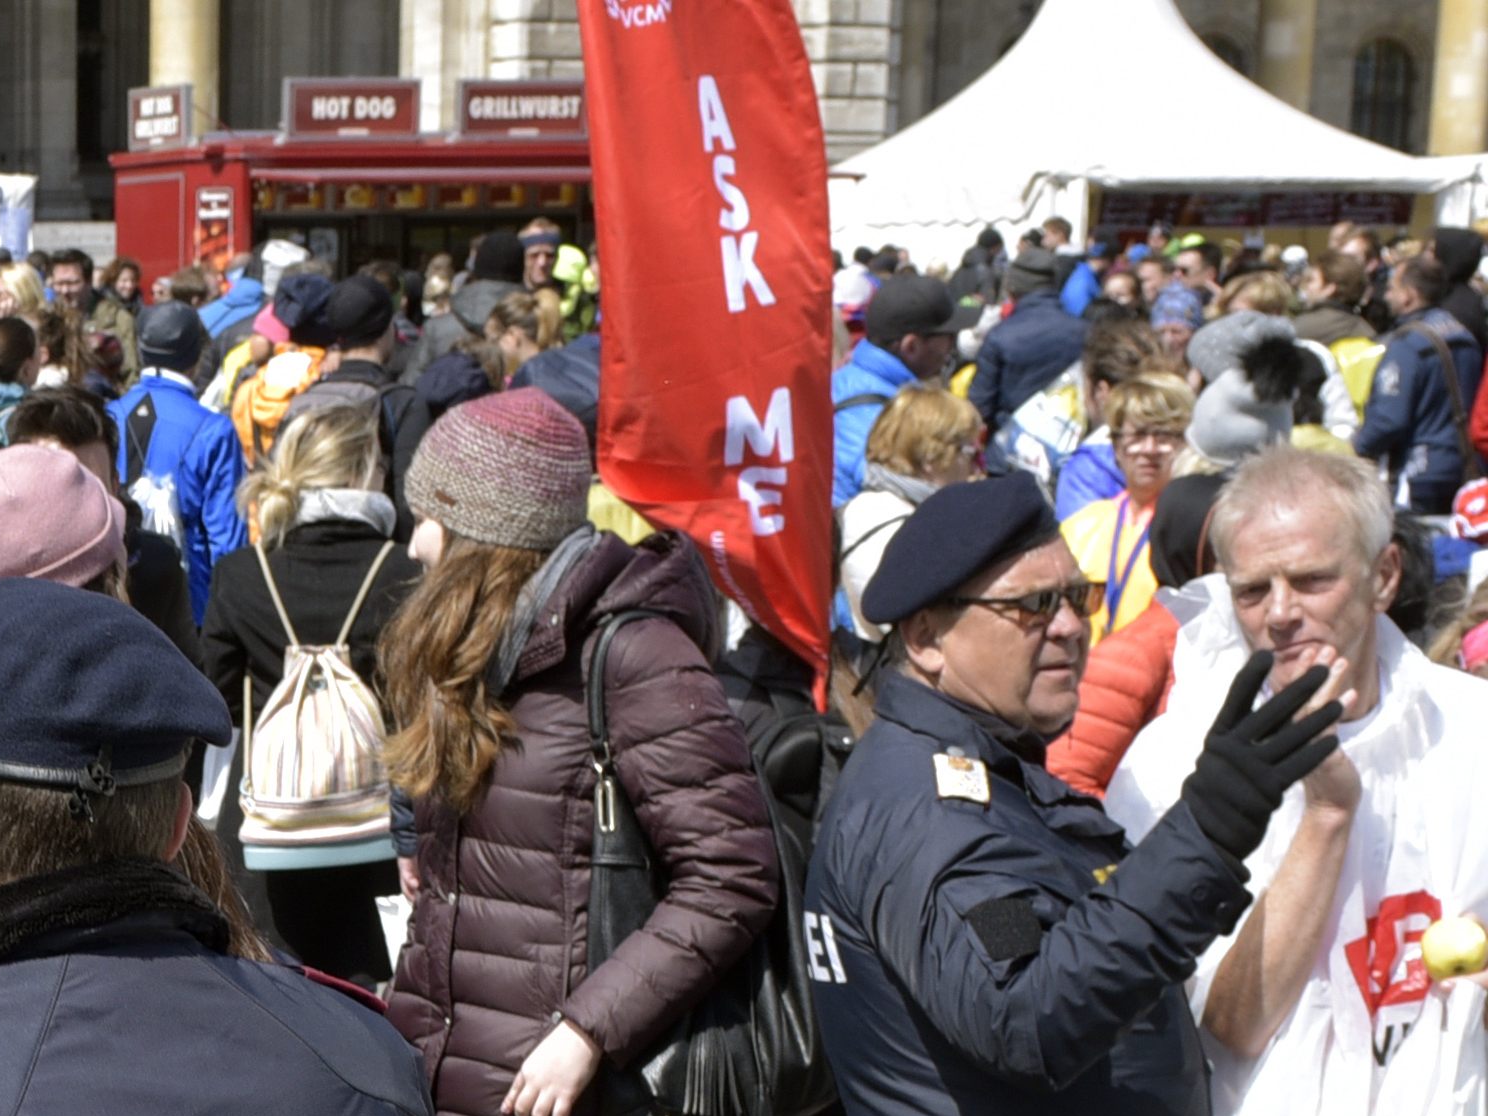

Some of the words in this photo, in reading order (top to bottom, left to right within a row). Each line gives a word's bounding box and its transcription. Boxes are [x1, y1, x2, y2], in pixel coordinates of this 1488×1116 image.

[619, 4, 667, 29] VCM
[312, 96, 351, 120] HOT
[354, 96, 396, 120] DOG
[469, 95, 581, 119] GRILLWURST
[698, 75, 777, 313] ASK
[724, 386, 794, 536] ME
[803, 911, 848, 984] EI
